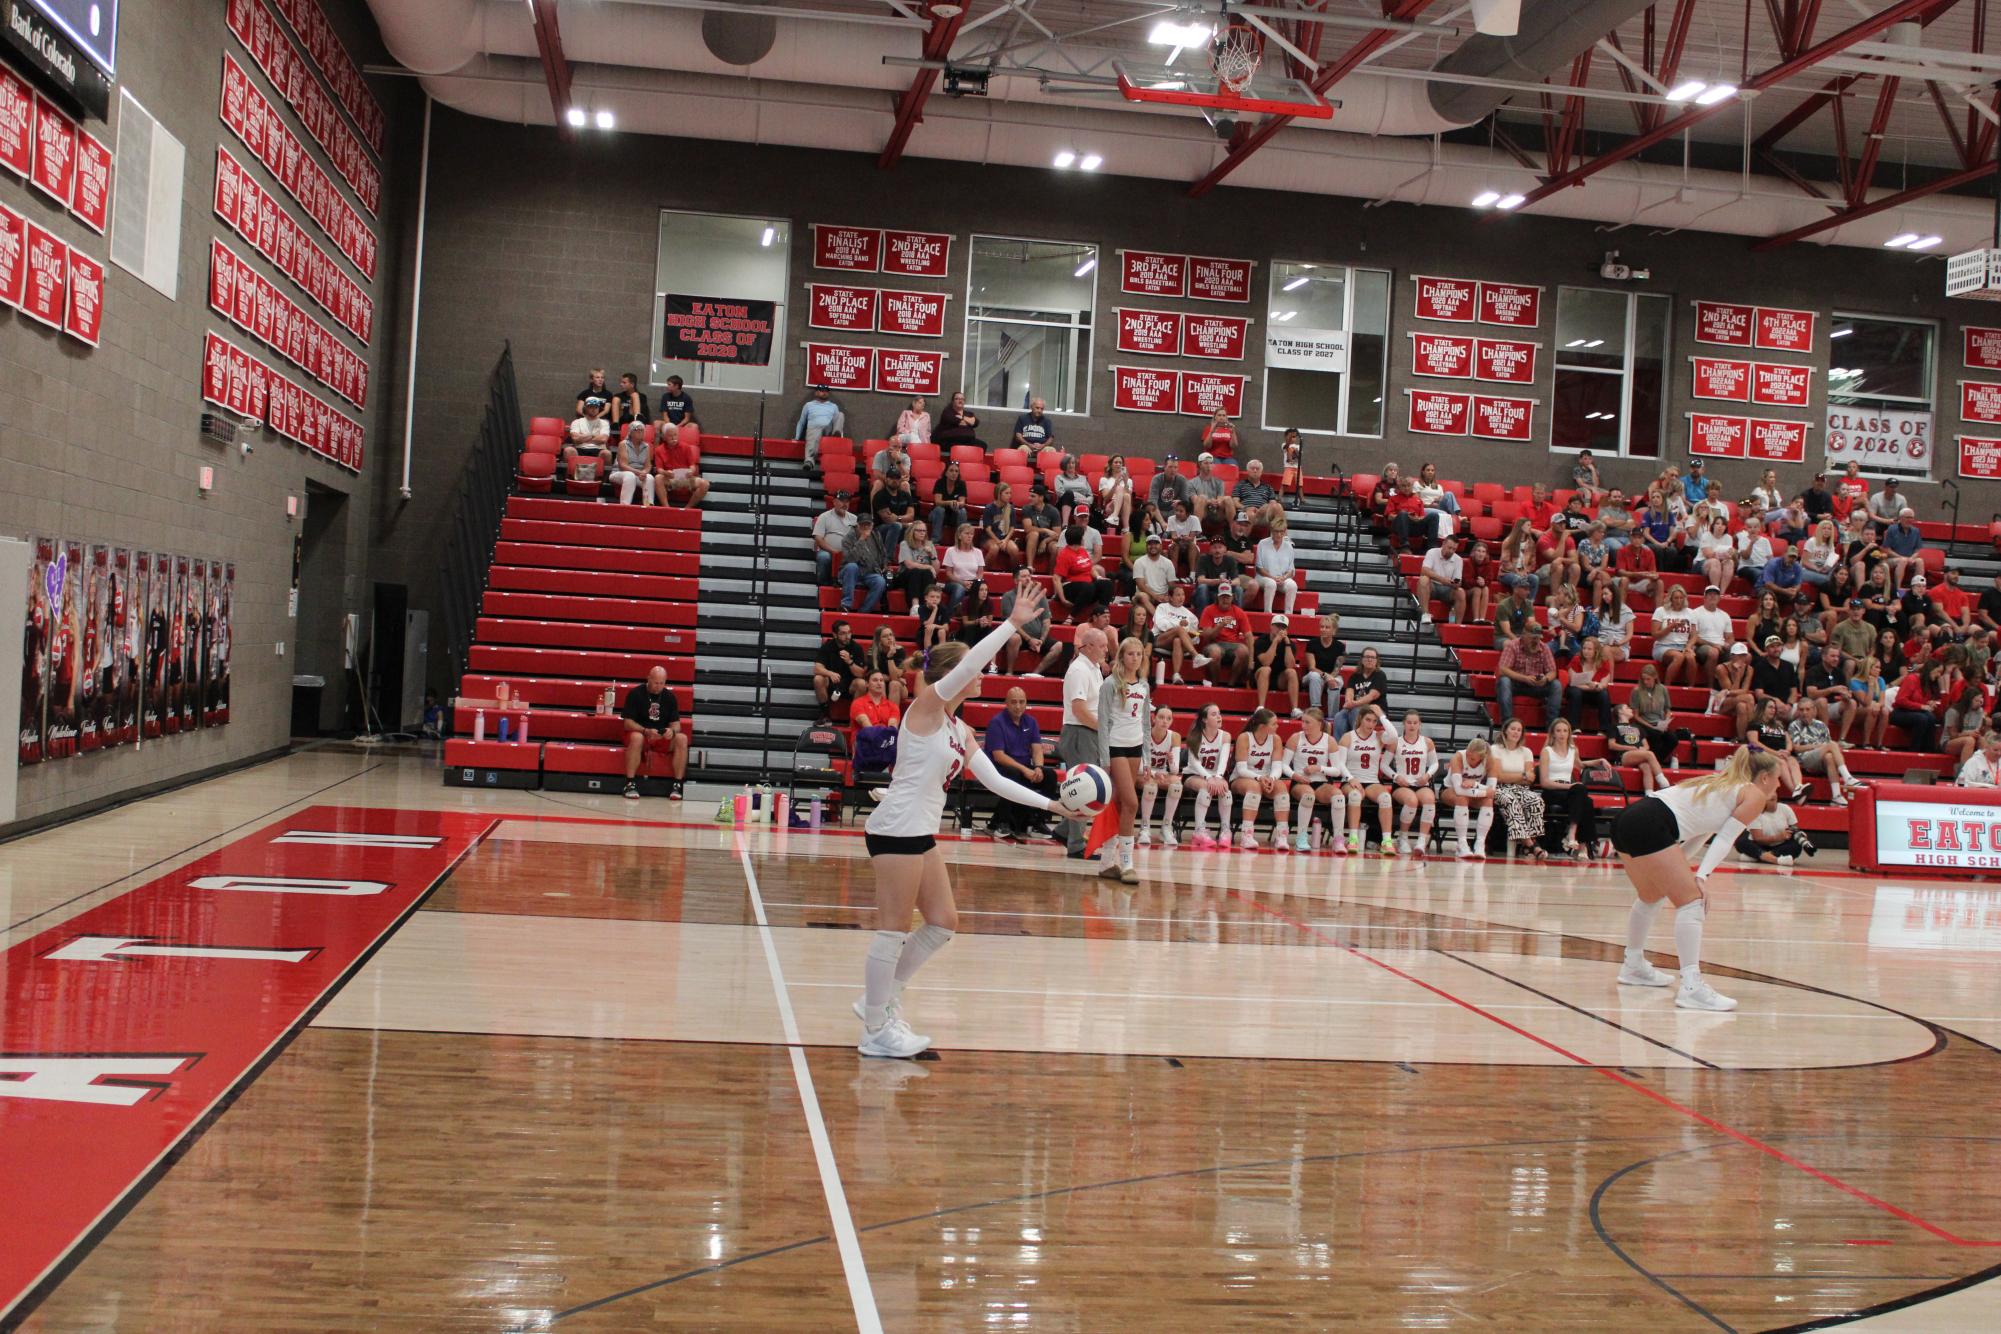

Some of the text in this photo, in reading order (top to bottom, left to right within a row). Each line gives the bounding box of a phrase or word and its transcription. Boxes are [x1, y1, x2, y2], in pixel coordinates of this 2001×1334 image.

[11, 4, 75, 82] Bank of Colorado
[828, 234, 868, 250] FINALIST
[892, 239, 940, 256] 2ND PLACE
[1131, 260, 1178, 276] 3RD PLACE
[1196, 266, 1243, 281] FINAL FOUR
[1423, 285, 1469, 301] CHAMPIONS
[1486, 291, 1531, 306] CHAMPIONS
[819, 293, 868, 310] 2ND PLACE
[888, 298, 937, 316] FINAL FOUR
[692, 303, 748, 318] EATON
[668, 314, 770, 333] HIGH SCHOOL
[1125, 318, 1173, 333] 2ND PLACE
[1703, 311, 1746, 326] 2ND PLACE
[1763, 317, 1806, 332] 4TH PLACE
[680, 329, 757, 345] CLASS OF
[1190, 323, 1238, 338] CHAMPIONS
[1420, 342, 1466, 358] CHAMPIONS
[1482, 347, 1527, 363] CHAMPIONS
[816, 353, 865, 368] FINAL FOUR
[885, 358, 934, 373] CHAMPIONS
[1701, 366, 1744, 381] CHAMPIONS
[1759, 371, 1805, 386] THIRD PLACE
[1123, 376, 1170, 392] FINAL FOUR
[1188, 381, 1235, 396] CHAMPIONS
[1968, 390, 1988, 401] FINAL
[1417, 399, 1462, 414] RUNNER UP
[1480, 405, 1524, 420] FINAL FOUR
[1698, 422, 1741, 437] CHAMPIONS
[1829, 415, 1927, 436] CLASS OF
[1756, 426, 1799, 441] CHAMPIONS
[1854, 436, 1899, 453] 2026
[1132, 703, 1138, 717] 2
[1201, 756, 1216, 769] 16
[1254, 759, 1264, 770] 4
[1361, 754, 1370, 769] 9
[1406, 758, 1420, 775] 18
[1950, 807, 1984, 817] Welcome
[1915, 854, 2000, 867] HIGH SCH
